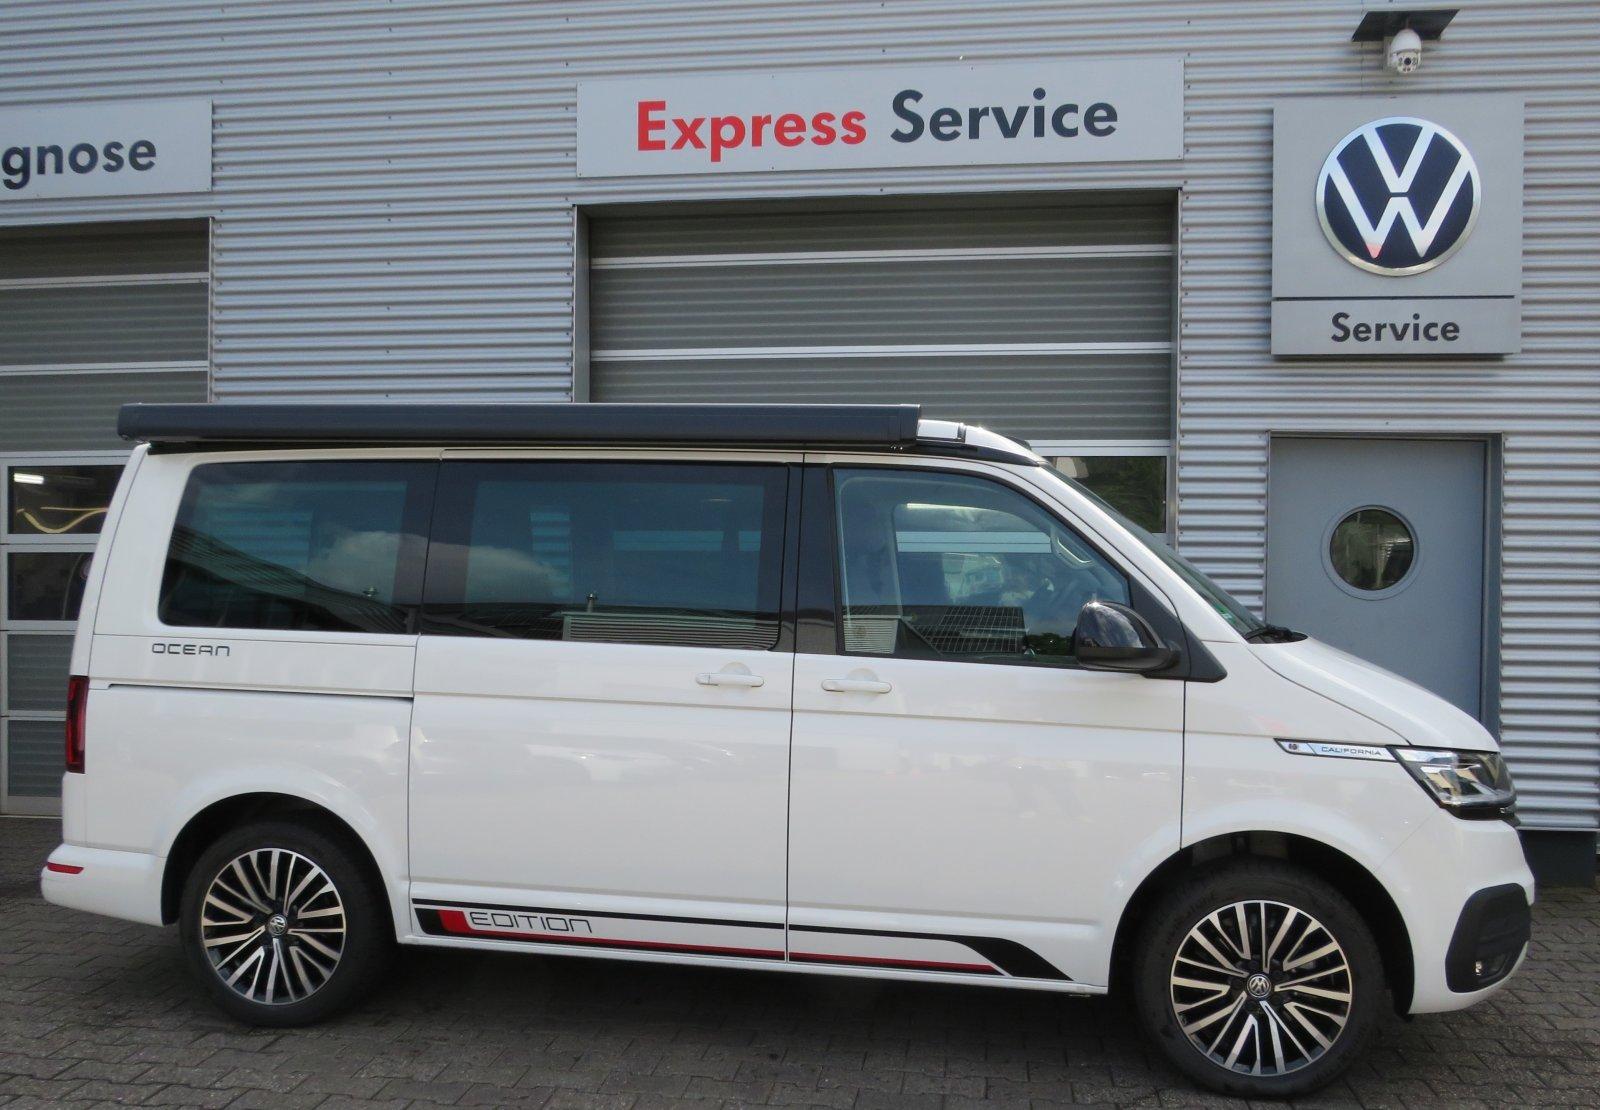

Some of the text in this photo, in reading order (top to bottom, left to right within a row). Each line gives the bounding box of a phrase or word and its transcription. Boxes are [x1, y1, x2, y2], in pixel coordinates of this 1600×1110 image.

[638, 87, 1118, 163] Express Service
[1, 139, 157, 190] gnose
[1331, 312, 1460, 342] Service
[151, 643, 230, 656] OCEAN
[1321, 746, 1382, 756] CALIFORNIA
[469, 911, 592, 933] EDITION
